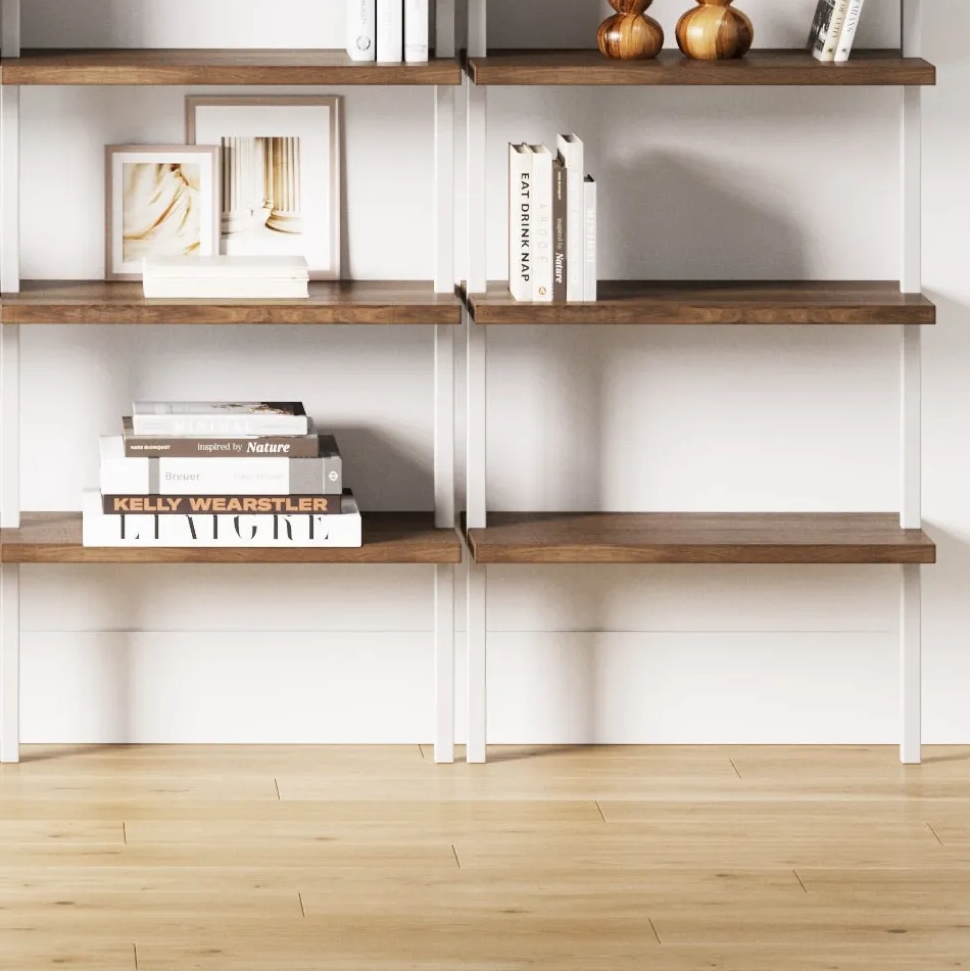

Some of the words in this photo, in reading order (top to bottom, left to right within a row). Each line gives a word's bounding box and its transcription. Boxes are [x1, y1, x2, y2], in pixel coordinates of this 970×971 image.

[521, 172, 530, 199] EAT
[521, 203, 530, 247] DRINK
[521, 252, 530, 282] NAP
[555, 252, 564, 283] Nature
[197, 442, 230, 453] Inspired
[232, 442, 243, 452] by
[246, 442, 291, 453] Nature
[165, 471, 200, 481] Breuer
[113, 498, 182, 511] KELLY
[189, 498, 328, 511] WEARSTLER
